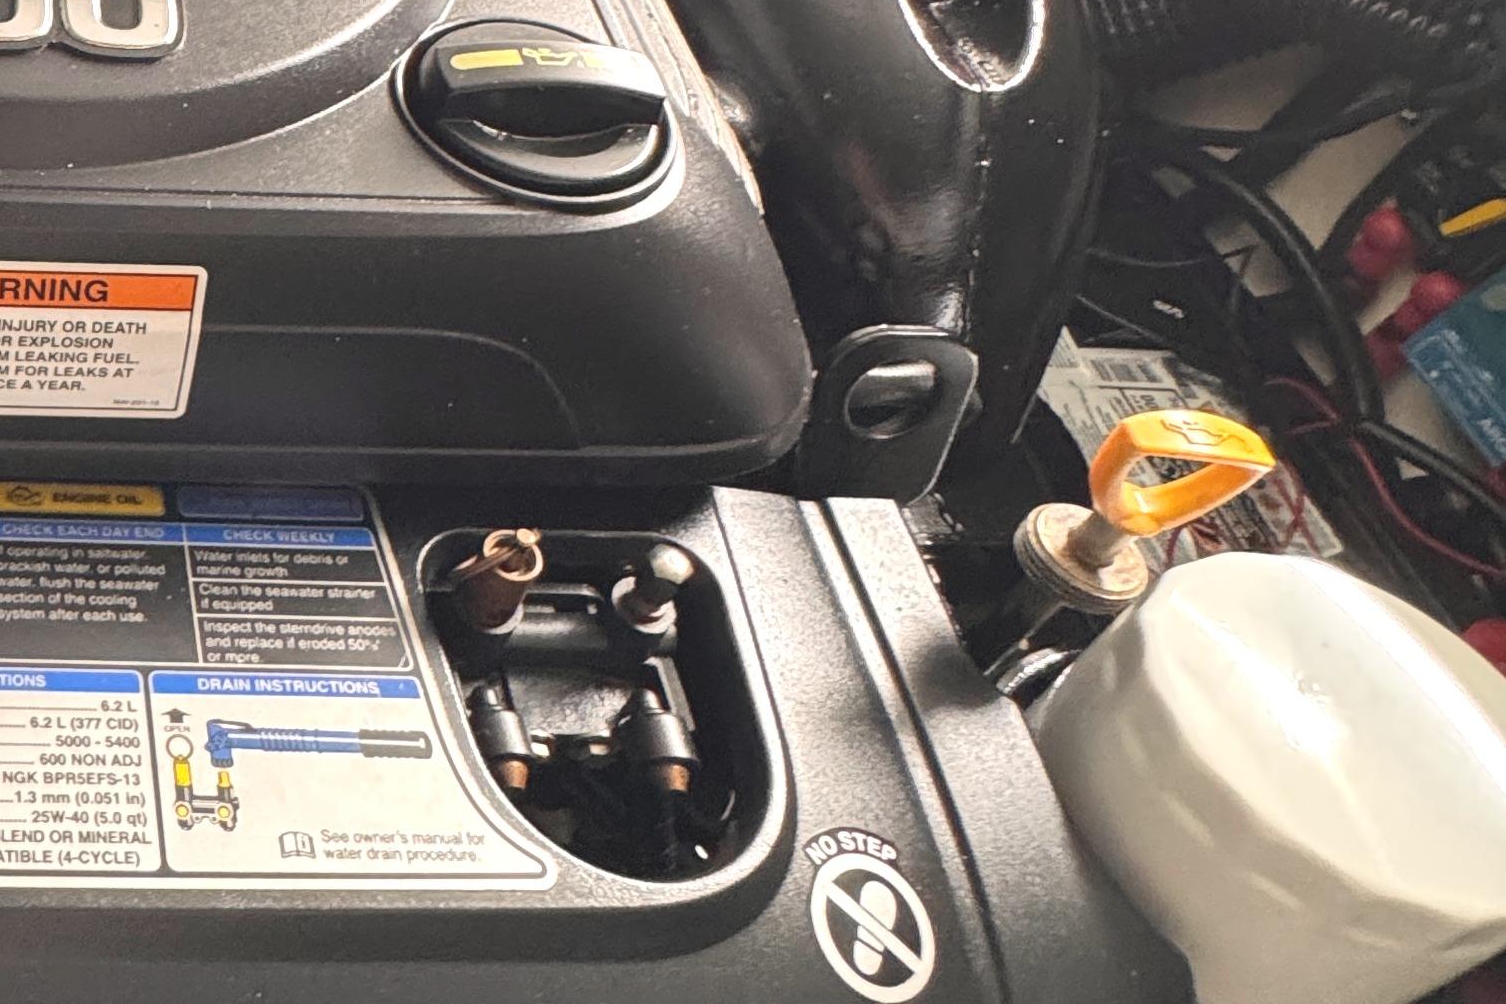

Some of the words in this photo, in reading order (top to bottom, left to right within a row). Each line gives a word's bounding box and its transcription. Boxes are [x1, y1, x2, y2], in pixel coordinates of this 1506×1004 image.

[62, 321, 86, 333] OR
[92, 322, 147, 334] DEATH
[18, 336, 114, 348] EXPLOSION
[15, 351, 88, 363] LEAKING
[94, 353, 140, 364] FUEL.
[15, 366, 48, 376] FOR
[54, 367, 108, 377] LEAKS
[113, 368, 134, 377] AT
[21, 380, 32, 389] A
[37, 381, 85, 391] YEAR.
[222, 530, 274, 540] CHECK
[278, 532, 335, 542] WEEKLY
[197, 678, 251, 691] DRAIN
[256, 680, 380, 694] INSTRUCTIONS
[101, 700, 123, 712] 6.2
[127, 701, 137, 712] L
[30, 717, 52, 728] 6.2
[57, 718, 66, 728] L
[71, 718, 101, 731] (377
[106, 719, 138, 732] CID)
[56, 736, 90, 747] 5000
[105, 737, 140, 748] 5400
[40, 754, 66, 765] 600
[72, 754, 106, 766] NON
[111, 755, 142, 767] ADJ
[2, 771, 38, 783] NGK
[44, 772, 140, 785] BPR5EFS-13
[15, 791, 36, 803] 1.3
[42, 795, 70, 804] mm
[75, 791, 120, 807] (0.051
[126, 793, 145, 807] in)
[32, 811, 89, 823] 25W-40
[94, 811, 121, 826] (5.0
[127, 813, 147, 827] qt)
[49, 831, 73, 843] OR
[79, 831, 152, 844] MINERAL
[321, 829, 349, 843] See
[353, 831, 408, 843] owner's
[412, 832, 463, 844] manual
[467, 832, 485, 845] for
[805, 835, 838, 865] NO
[837, 831, 897, 861] STEP
[58, 850, 140, 866] (4-CYCLE)
[324, 848, 361, 859] water
[367, 848, 402, 861] drain
[406, 850, 481, 864] procedure.
